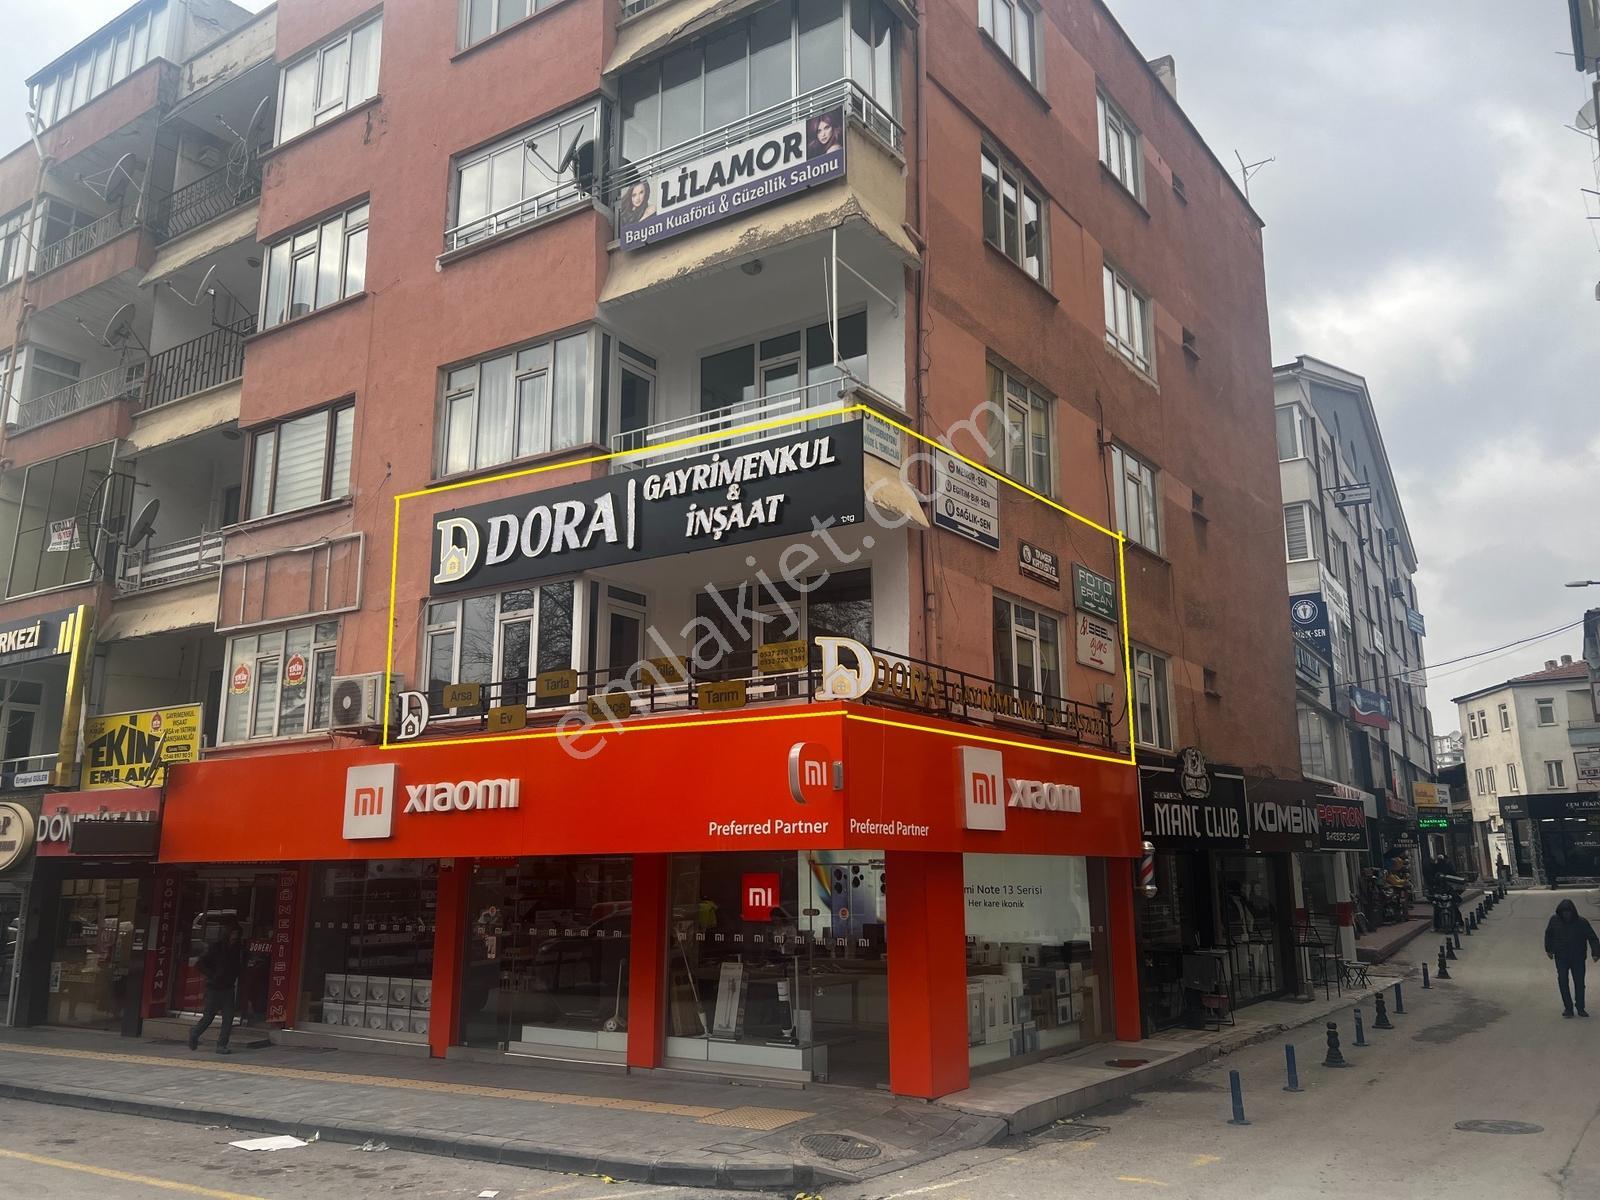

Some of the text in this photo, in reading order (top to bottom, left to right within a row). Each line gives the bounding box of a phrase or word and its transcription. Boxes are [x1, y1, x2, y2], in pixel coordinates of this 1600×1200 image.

[660, 131, 803, 209] LİLAMOR
[625, 156, 839, 244] Bayan Kuaförü & Güzellik Salonu
[643, 436, 836, 501] GAYRİMENKUL
[726, 483, 741, 501] &
[485, 491, 618, 566] DORA
[684, 494, 785, 541] İNŞAAT
[955, 506, 991, 531] SAĞLIK-SEN
[1078, 569, 1113, 595] FOTO
[1080, 585, 1113, 608] ERCAN
[544, 677, 570, 691] Tarla
[872, 655, 939, 705] DORA
[451, 690, 472, 701] Arsa
[705, 689, 739, 705] Tarım
[500, 713, 514, 725] Ev
[88, 715, 158, 767] EKİN
[403, 778, 520, 814] xiaomi
[1006, 778, 1081, 813] xiaomi
[709, 819, 828, 836] Preferred Partner
[850, 818, 929, 837] Preferred Partner
[1154, 802, 1240, 838] MANÇ CLUB
[1253, 799, 1319, 834] KOMBİN
[977, 885, 1000, 895] Note
[1003, 885, 1014, 895] 13
[1017, 885, 1043, 895] Serisi
[984, 900, 999, 908] kare
[1001, 900, 1024, 908] ikonik
